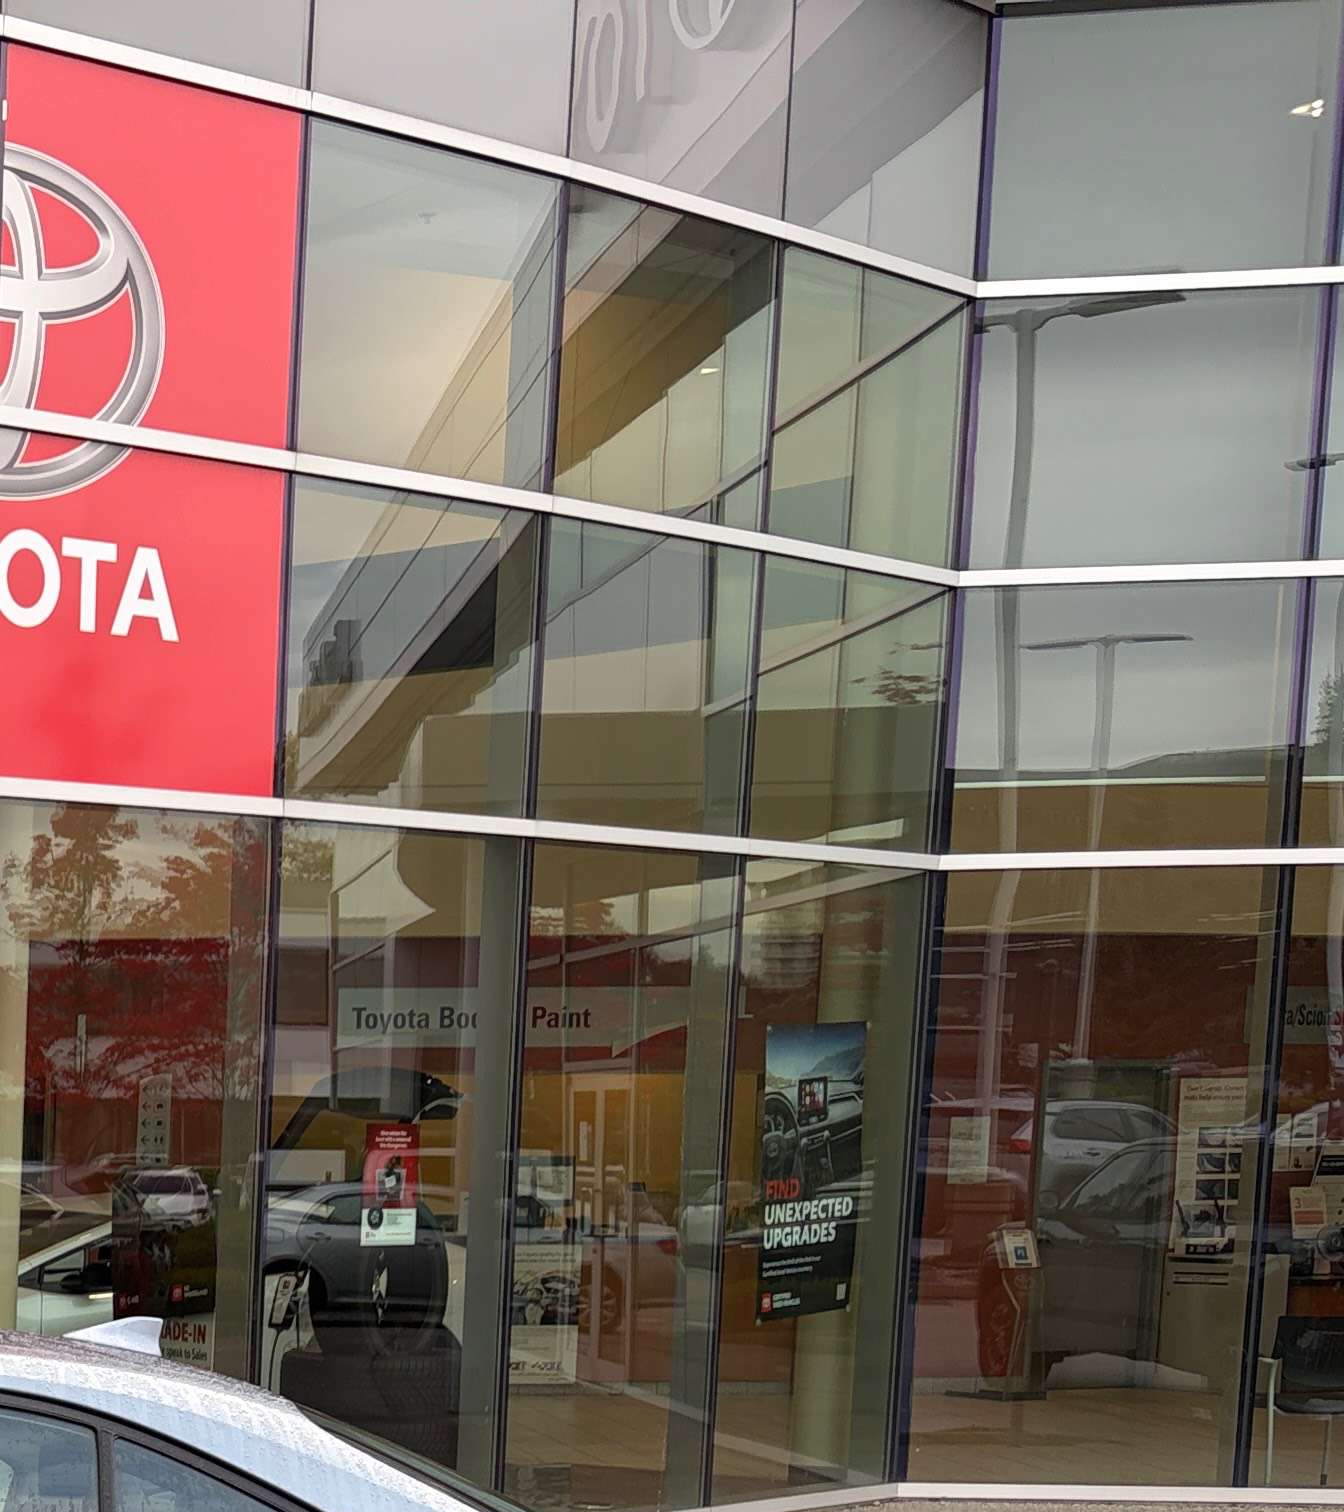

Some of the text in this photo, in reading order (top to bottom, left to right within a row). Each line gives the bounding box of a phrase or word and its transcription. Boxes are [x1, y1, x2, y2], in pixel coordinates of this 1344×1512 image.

[352, 1006, 430, 1034] Toyota
[531, 1005, 591, 1029] Paint
[766, 1178, 800, 1200] FIND
[764, 1196, 853, 1225] UNEXPECTED
[763, 1221, 837, 1250] UPGRADES
